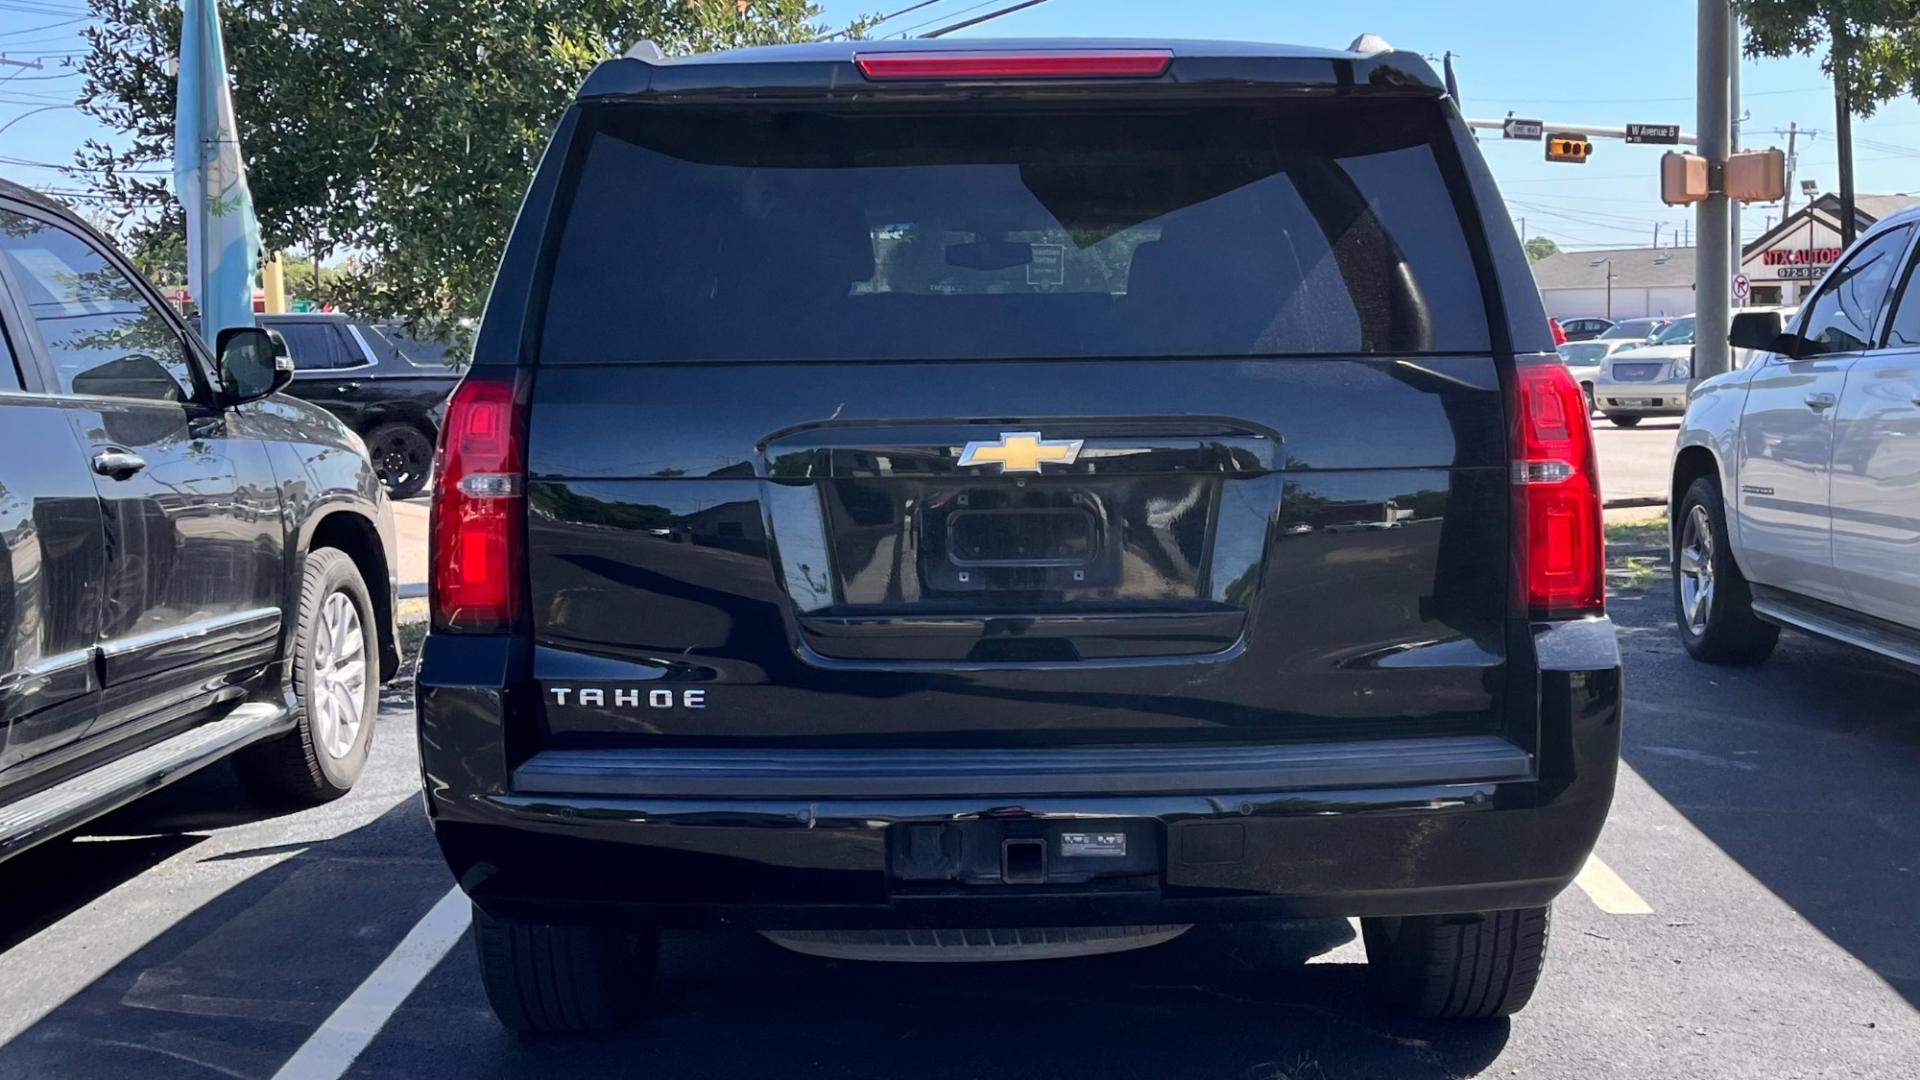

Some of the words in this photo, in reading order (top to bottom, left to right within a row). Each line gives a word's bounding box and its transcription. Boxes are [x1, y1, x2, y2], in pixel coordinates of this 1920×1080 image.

[1631, 125, 1640, 135] W
[1640, 126, 1668, 136] Avenue
[1668, 126, 1675, 136] B
[1763, 249, 1791, 265] NTX
[550, 688, 706, 708] TAHOE
